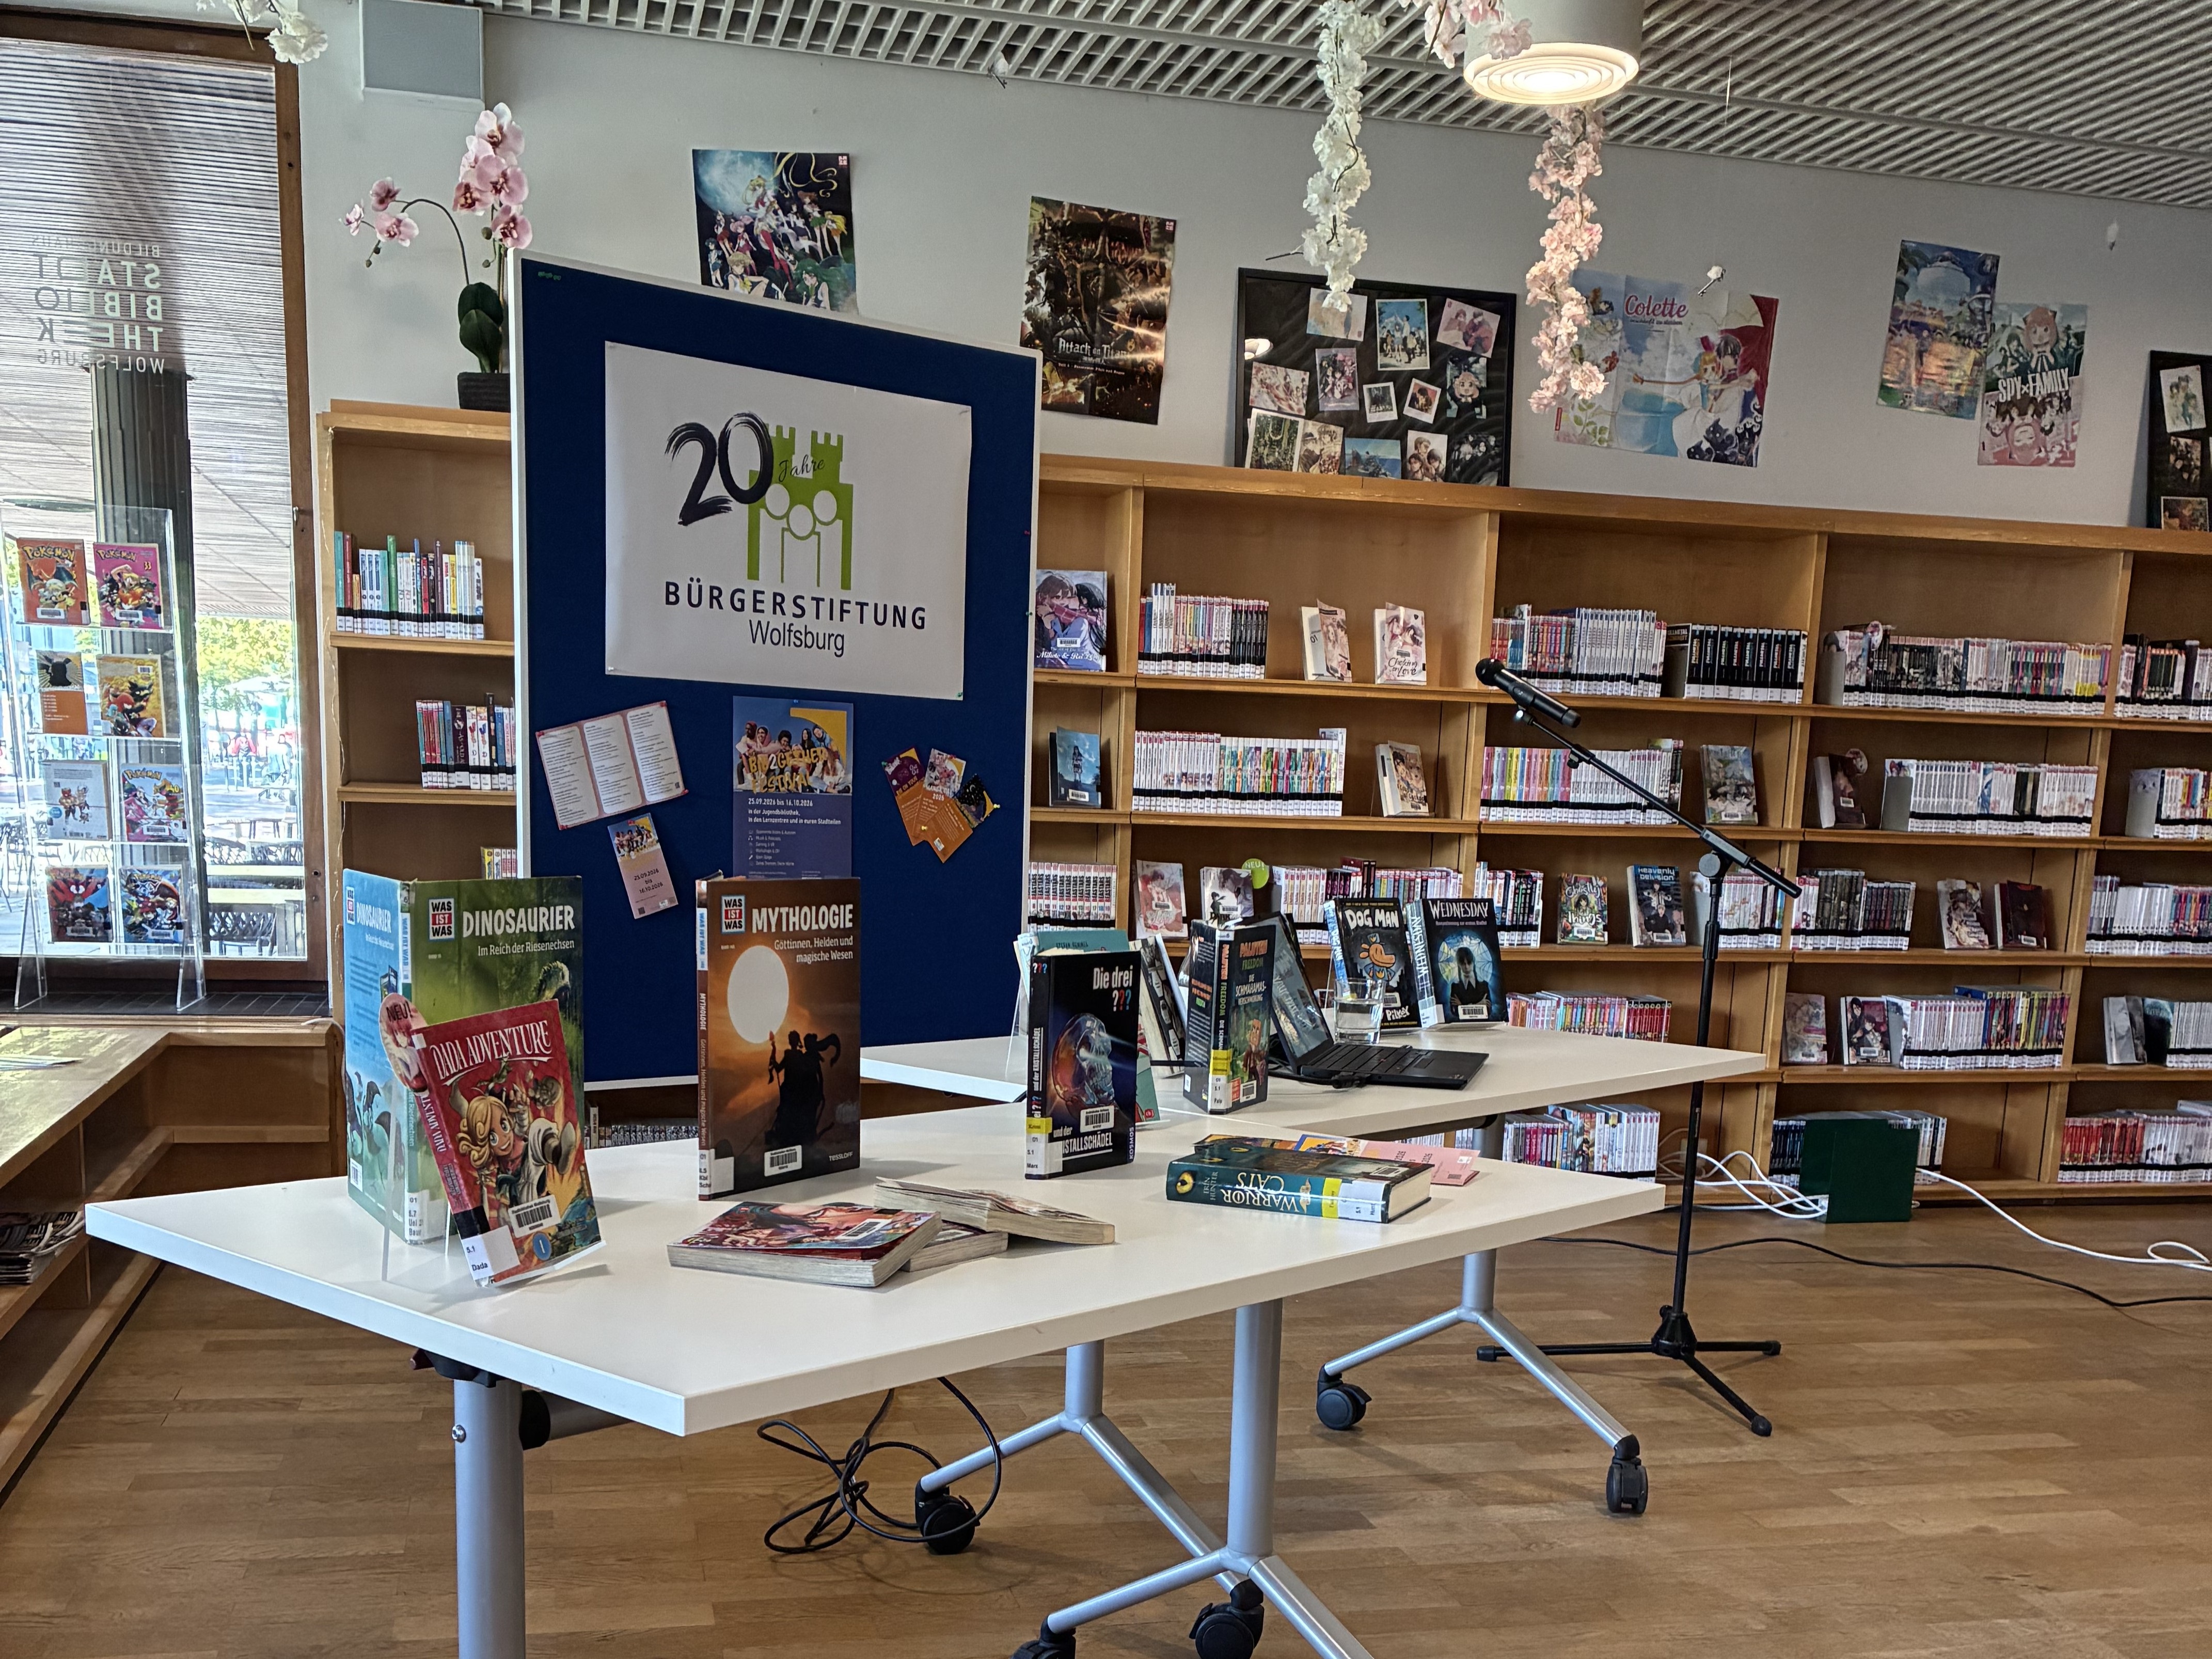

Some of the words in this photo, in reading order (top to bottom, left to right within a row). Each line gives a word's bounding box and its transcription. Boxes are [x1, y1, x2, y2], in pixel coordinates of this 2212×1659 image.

[1624, 294, 1689, 318] Colette
[1058, 337, 1091, 356] Attack
[664, 412, 774, 526] 20
[778, 454, 826, 483] Jahre
[143, 561, 152, 571] 33
[665, 576, 926, 630] BÜRGERSTIFTUNG
[749, 620, 846, 658] Wolfsburg
[1244, 861, 1265, 871] NEU!
[431, 900, 452, 912] WAS
[724, 898, 742, 908] WAS
[1428, 900, 1488, 920] WEDNESDAY
[356, 902, 391, 934] DINOSAURIER
[435, 914, 449, 925] IST
[463, 905, 576, 938] DINOSAURIER
[728, 909, 740, 919] IST
[751, 904, 853, 934] MYTHOLOGIE
[1344, 909, 1373, 930] DOG
[1374, 908, 1399, 928] MAN
[432, 926, 453, 937] WAS
[724, 920, 743, 930] WAS
[478, 945, 488, 957] Im
[489, 943, 511, 956] Reich
[512, 942, 524, 954] der
[525, 939, 575, 953] Riesenechsen
[774, 937, 812, 951] Göttinnen,
[814, 936, 838, 947] Helden
[840, 935, 853, 945] und
[1410, 916, 1429, 978] WEDNESDAY
[796, 951, 830, 965] magische
[830, 950, 854, 960] Wesen
[1242, 957, 1264, 971] FREEDOM
[1093, 966, 1110, 990] Die
[1111, 965, 1133, 989] drei
[386, 1001, 414, 1023] NEU!
[1385, 1005, 1410, 1021] Pilkey
[430, 1040, 468, 1080] DADA
[465, 1020, 552, 1065] ADVENTURE
[1053, 1127, 1062, 1138] und
[1063, 1126, 1073, 1136] der
[1062, 1131, 1113, 1155] ISTALLSCHÄDEL
[1210, 1171, 1219, 1200] HUNTER
[1237, 1172, 1285, 1192] CATS
[1220, 1189, 1300, 1213] WARRIOR
[466, 1245, 476, 1254] 5.1
[471, 1261, 488, 1271] Dada
